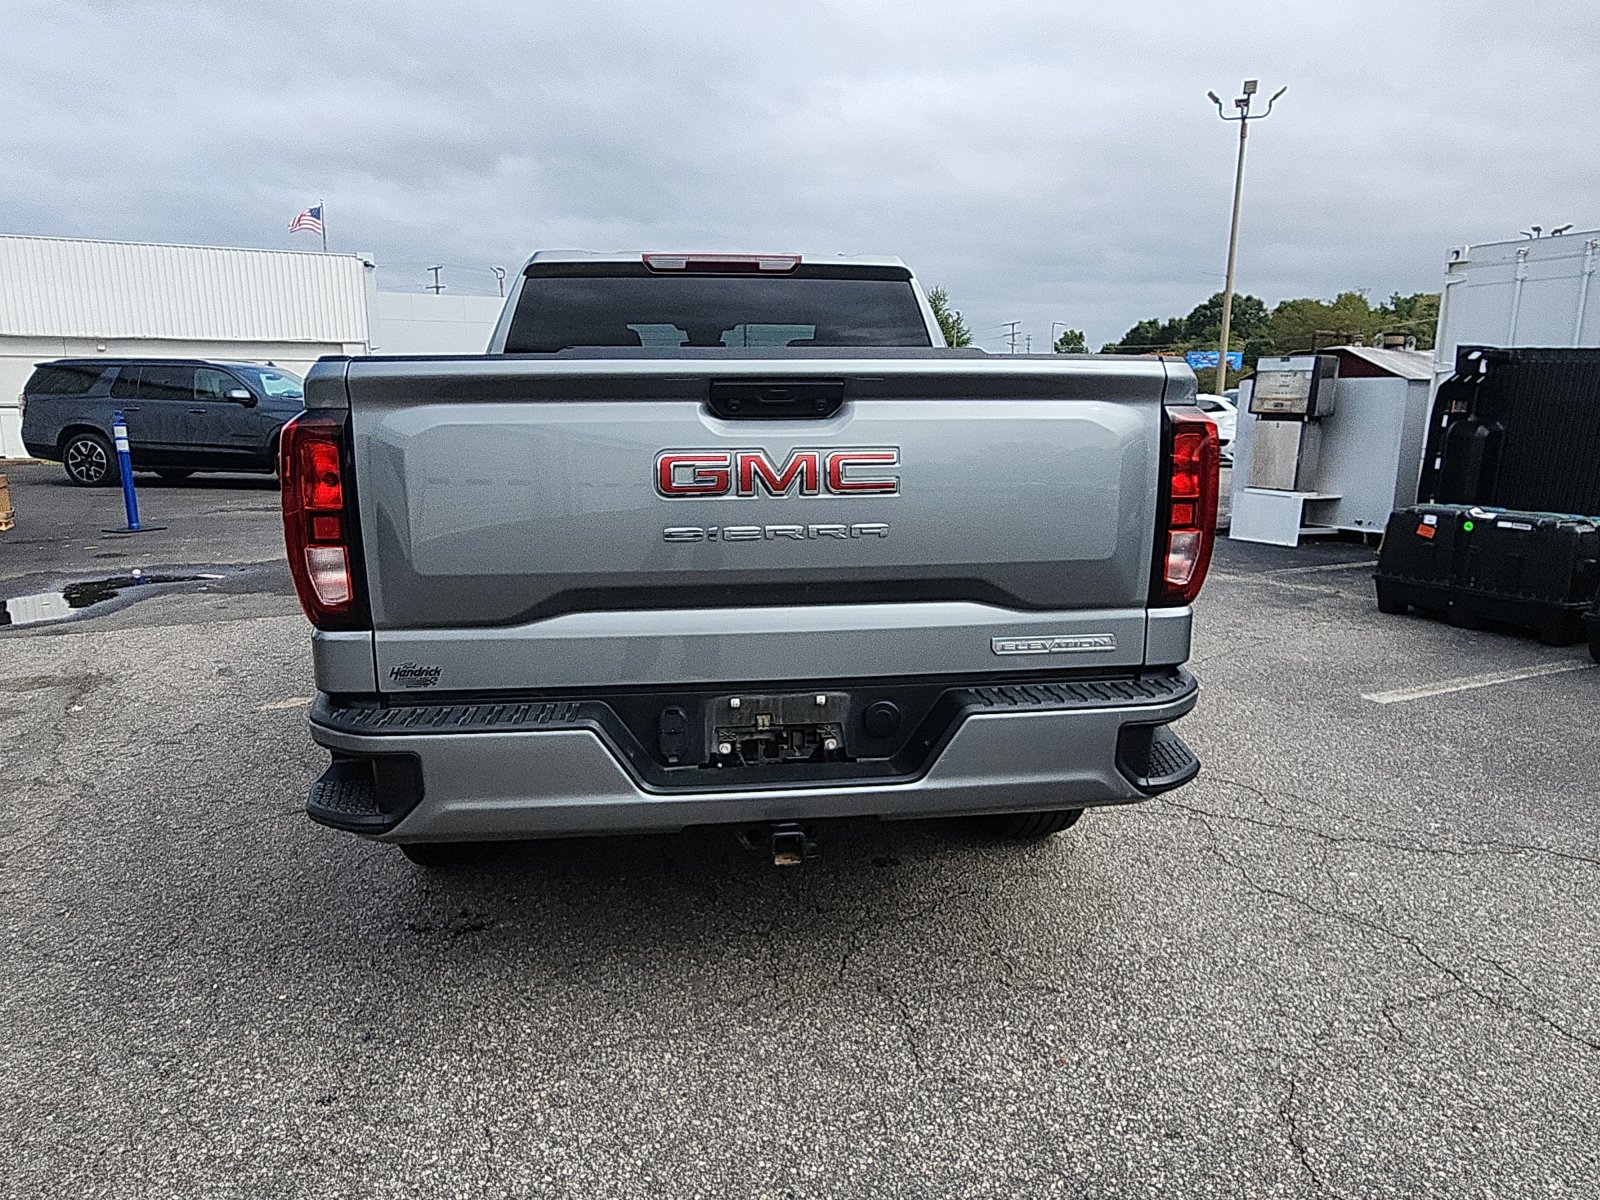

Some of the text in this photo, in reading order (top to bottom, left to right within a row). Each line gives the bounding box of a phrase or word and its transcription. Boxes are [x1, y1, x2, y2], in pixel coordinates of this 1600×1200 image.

[655, 447, 900, 498] GMC
[663, 523, 890, 542] SIERRA
[998, 636, 1114, 651] ELEVATION
[389, 666, 442, 680] Hendrick
